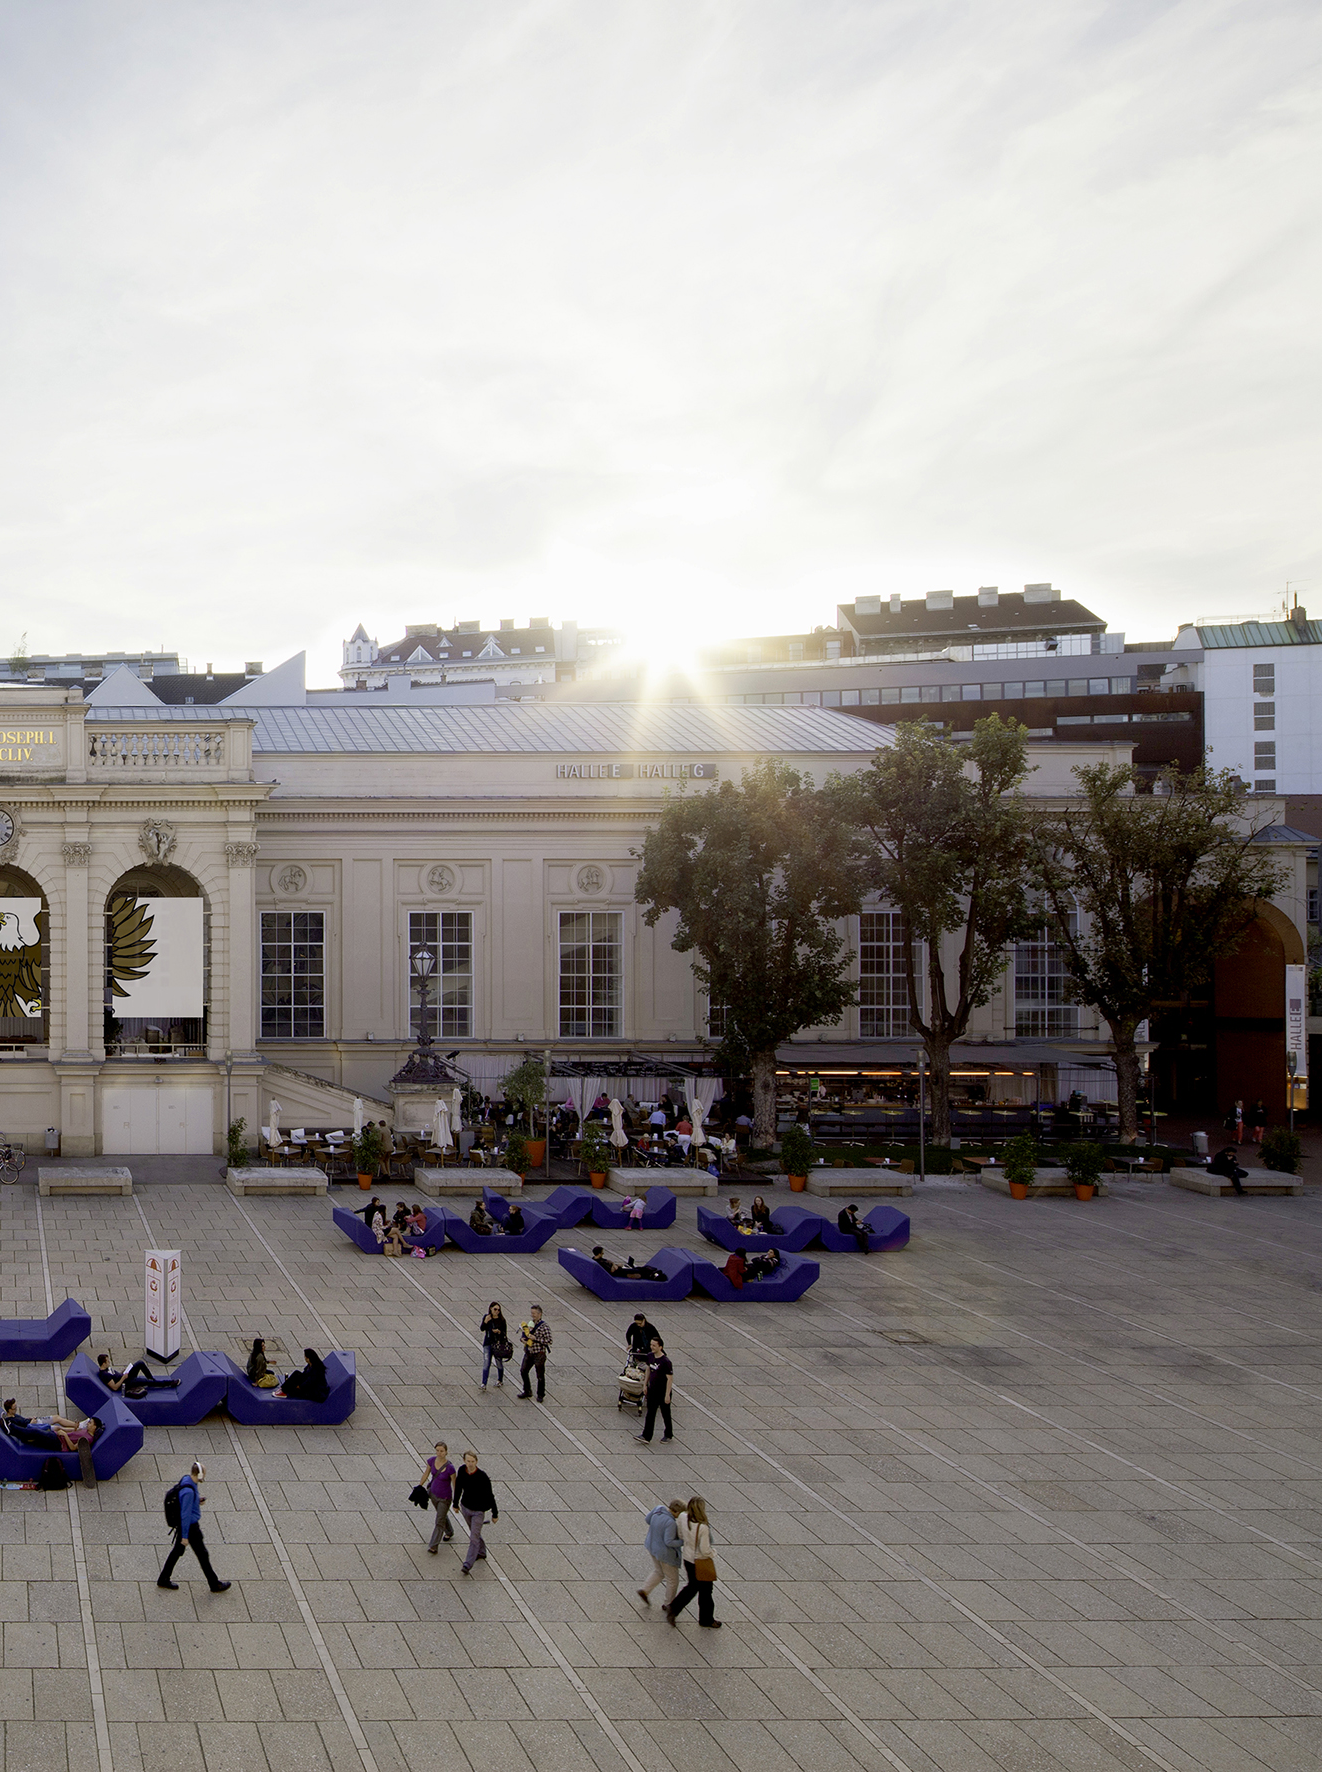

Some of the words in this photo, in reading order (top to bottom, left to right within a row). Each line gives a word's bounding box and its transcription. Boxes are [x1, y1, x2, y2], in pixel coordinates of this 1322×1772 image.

[556, 764, 608, 778] HALLE
[612, 764, 621, 778] E
[693, 764, 704, 777] G
